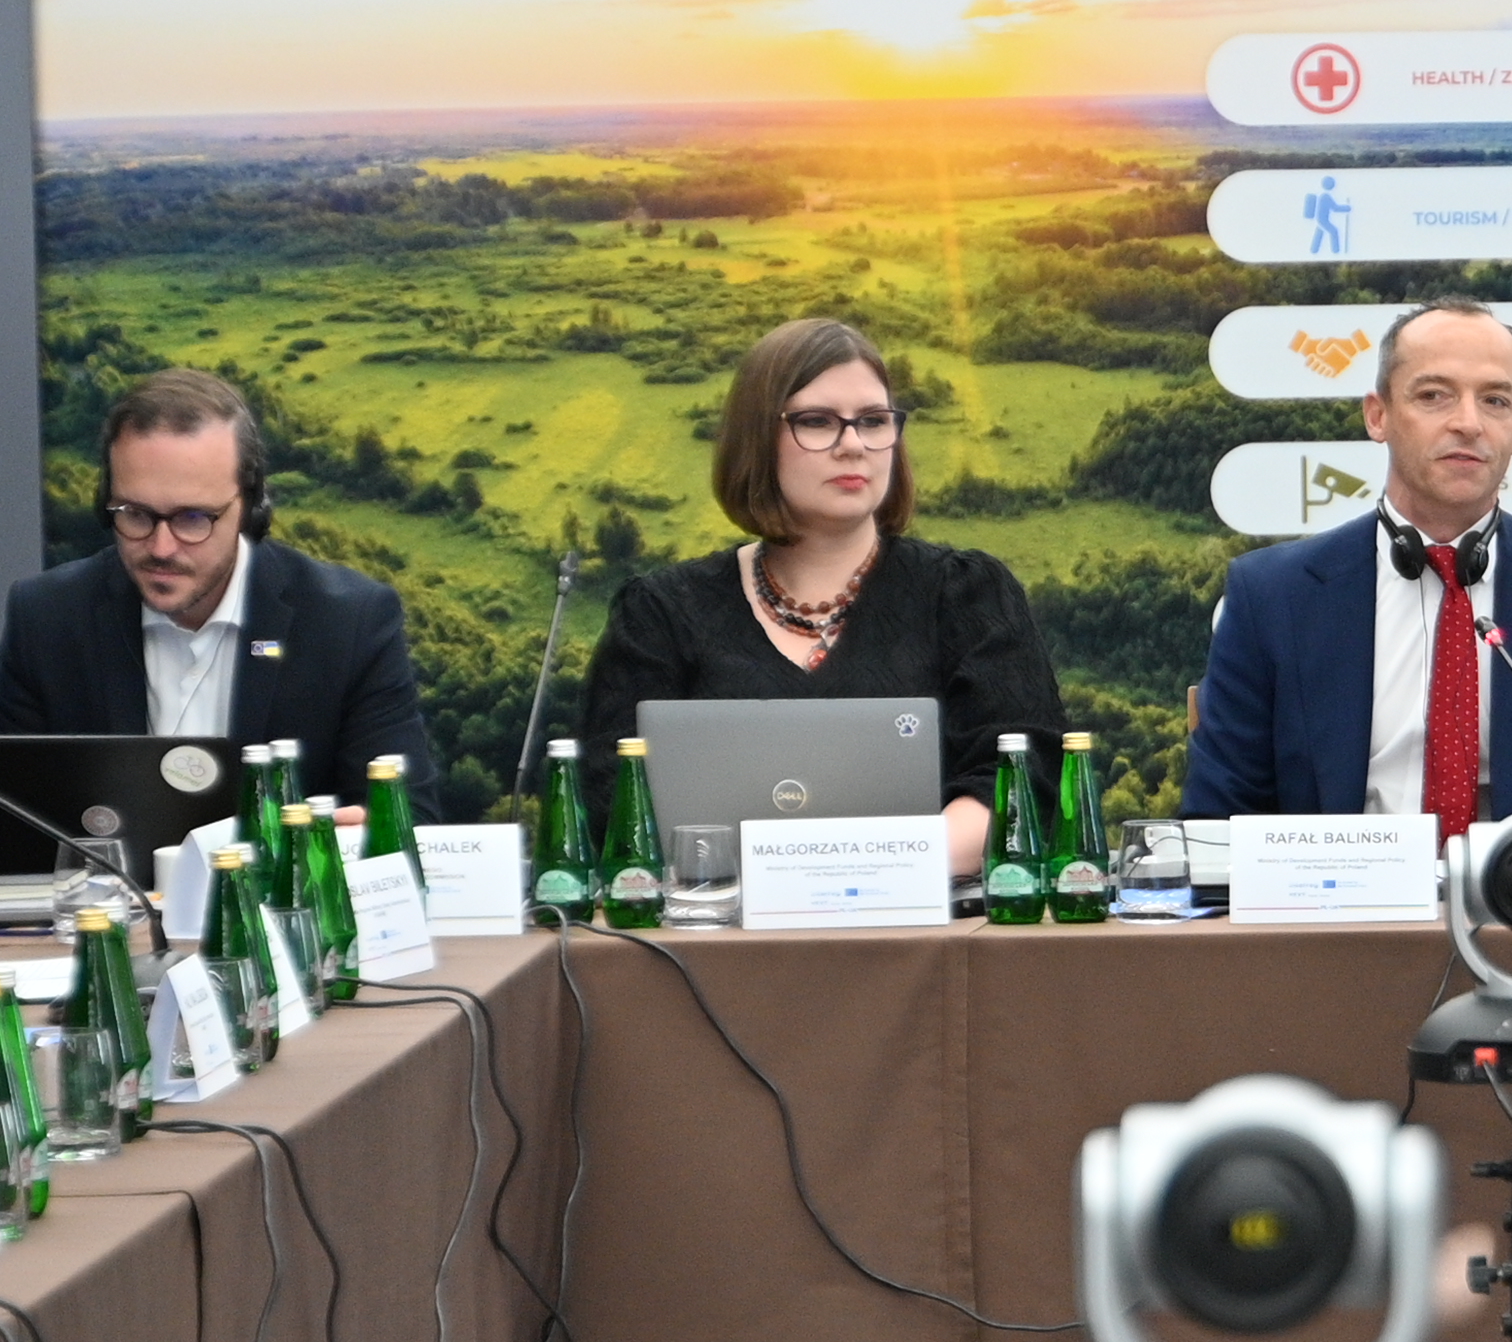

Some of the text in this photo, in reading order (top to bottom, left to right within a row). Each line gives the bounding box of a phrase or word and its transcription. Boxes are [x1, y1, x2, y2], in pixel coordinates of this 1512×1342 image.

[1411, 69, 1484, 85] HEALTH
[1489, 67, 1498, 87] /
[1413, 211, 1497, 226] TOURISM
[1501, 208, 1511, 227] /
[776, 790, 803, 801] DELL
[1264, 829, 1399, 844] RAFAŁ BALIŃSKI
[417, 841, 482, 855] CHALEK
[752, 840, 929, 856] MAŁGORZATA CHĘTKO
